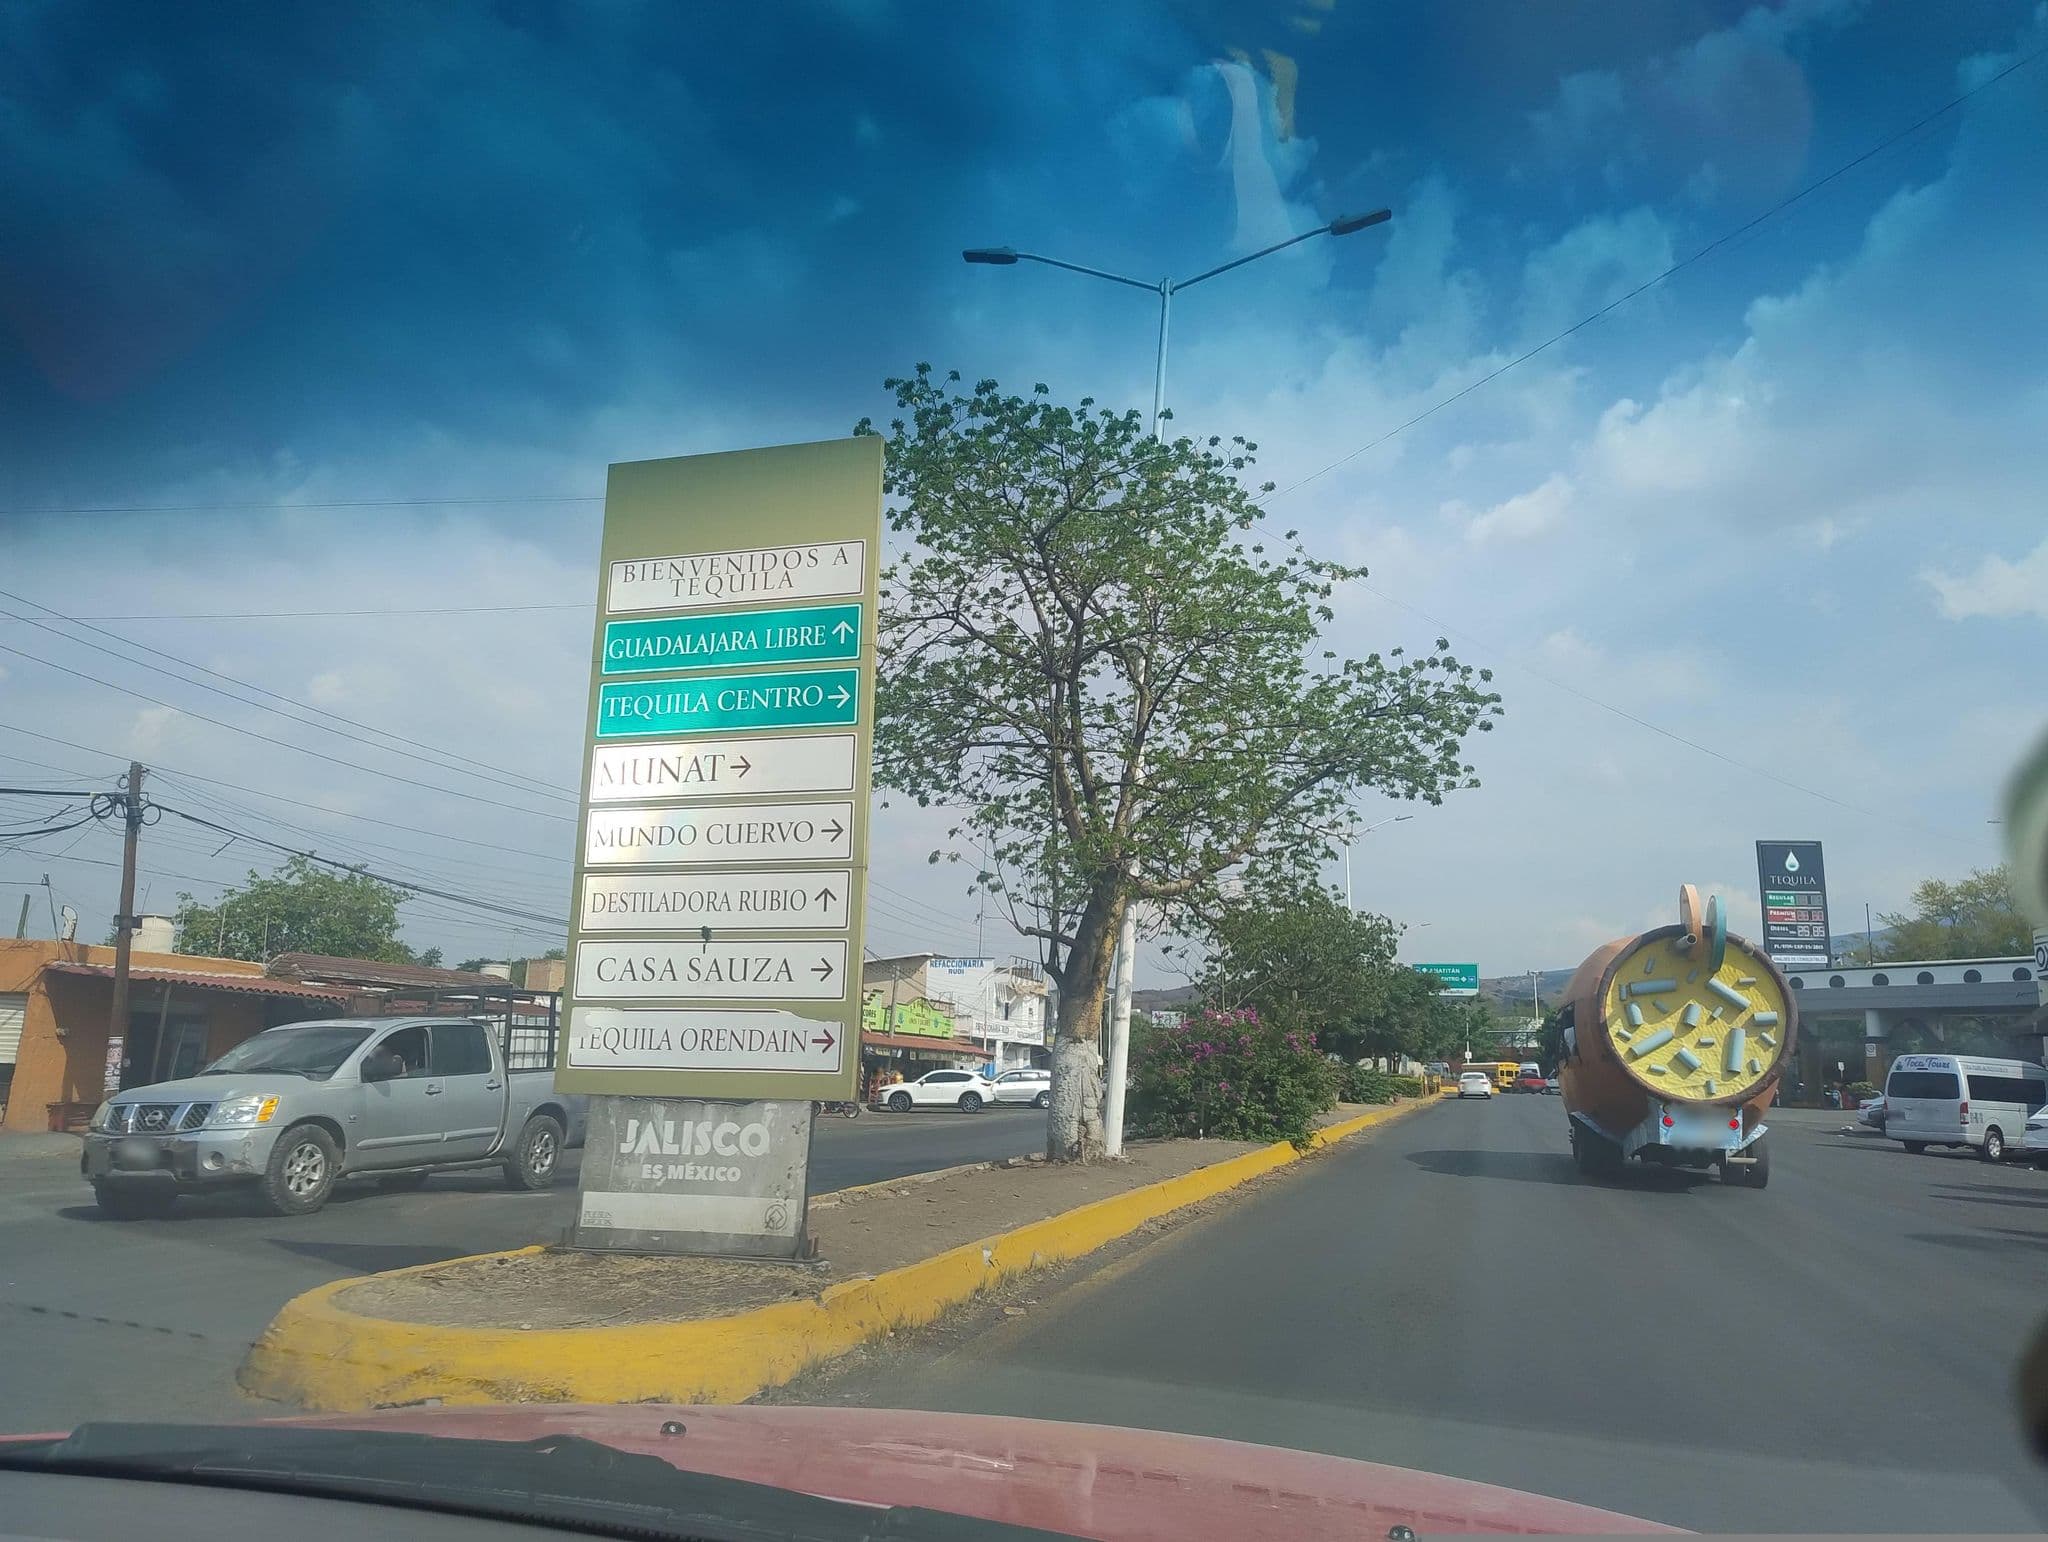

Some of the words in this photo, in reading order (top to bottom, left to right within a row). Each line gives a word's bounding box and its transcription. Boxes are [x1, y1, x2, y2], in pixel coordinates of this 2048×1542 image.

[622, 547, 820, 583] BIENVENIDOS
[832, 546, 849, 566] A
[671, 570, 794, 598] TEQUILA
[608, 630, 759, 660] GUADALAJARA
[765, 624, 826, 650] LIBRE
[604, 691, 710, 720] TEQUILA
[717, 685, 824, 711] CENTRO
[600, 754, 725, 787] MUNAT
[594, 824, 698, 849] MUNDO
[705, 820, 815, 845] CUERVO
[1769, 874, 1817, 887] TEQUILA
[591, 890, 732, 914] DESTILADORA
[738, 888, 807, 913] RUBIO
[596, 957, 677, 983] CASA
[686, 956, 795, 983] SAUZA
[929, 959, 985, 969] REFACCIONARIA
[680, 1028, 808, 1053] ORENDAIN
[619, 1118, 771, 1158] JALISCO
[641, 1163, 663, 1180] ES
[667, 1162, 741, 1182] MÉXICO
